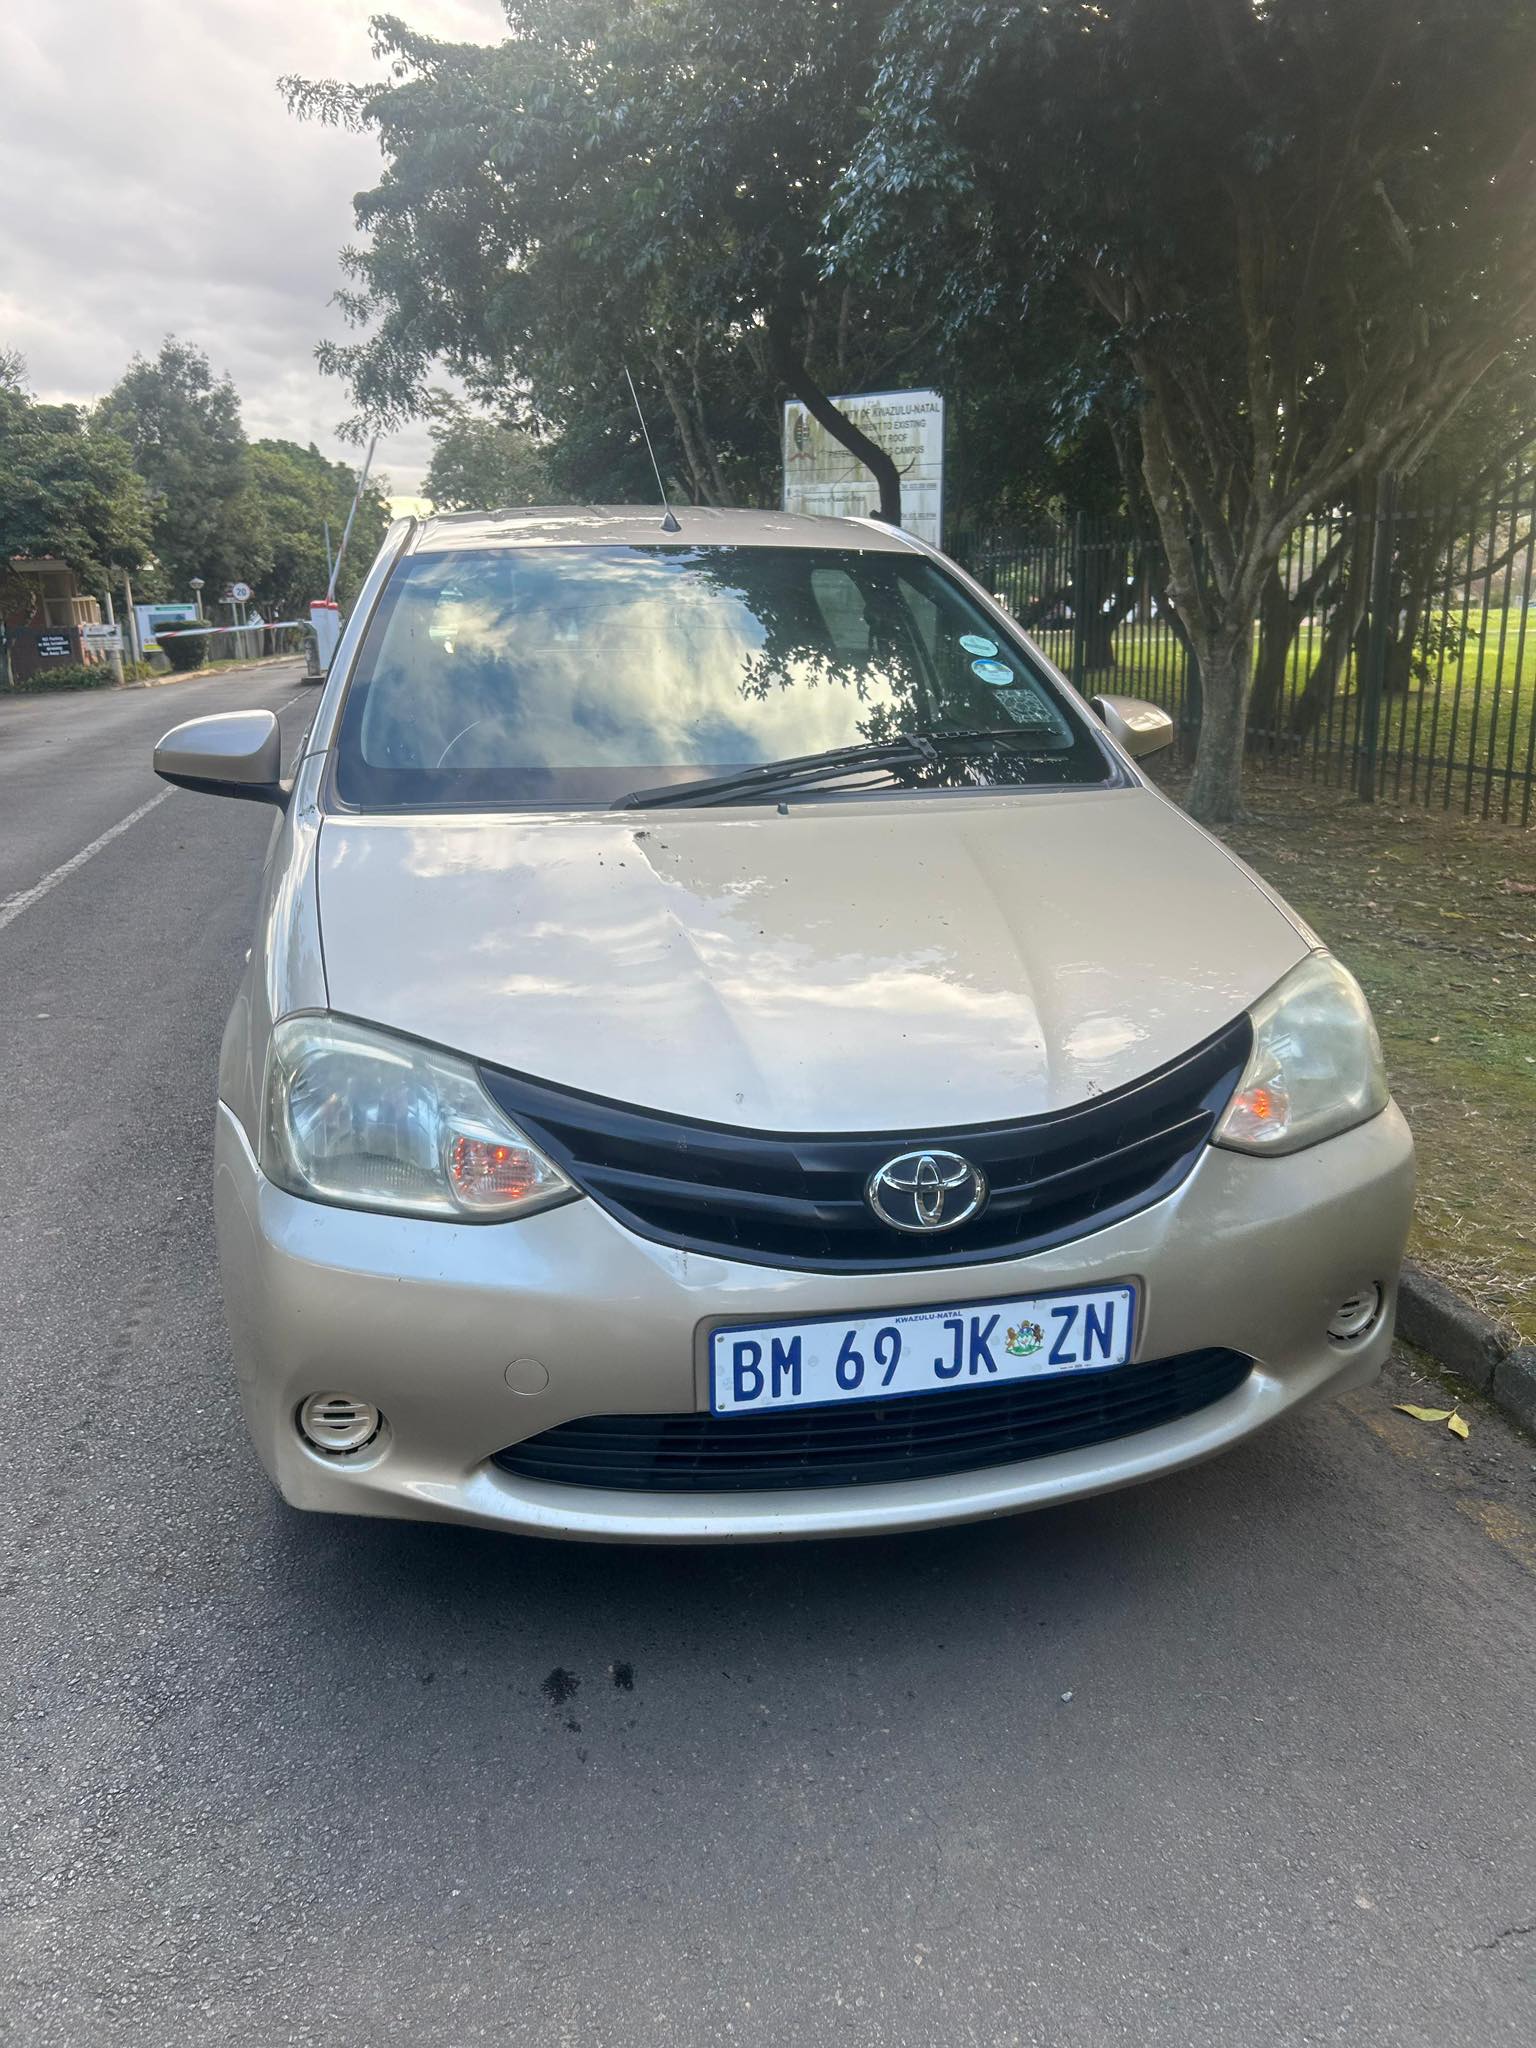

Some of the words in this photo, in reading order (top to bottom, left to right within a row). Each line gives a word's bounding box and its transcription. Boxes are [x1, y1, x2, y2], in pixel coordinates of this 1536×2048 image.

[872, 403, 940, 417] KWAZULU-NATAL
[893, 419, 926, 430] EXISTING
[894, 446, 924, 455] CAMPUS
[236, 587, 247, 597] 20
[895, 1310, 963, 1324] KWAZULU-NATAL
[732, 1335, 802, 1402] BM
[835, 1326, 902, 1391] 69
[934, 1314, 1001, 1380] JK
[1048, 1301, 1115, 1366] ZN
